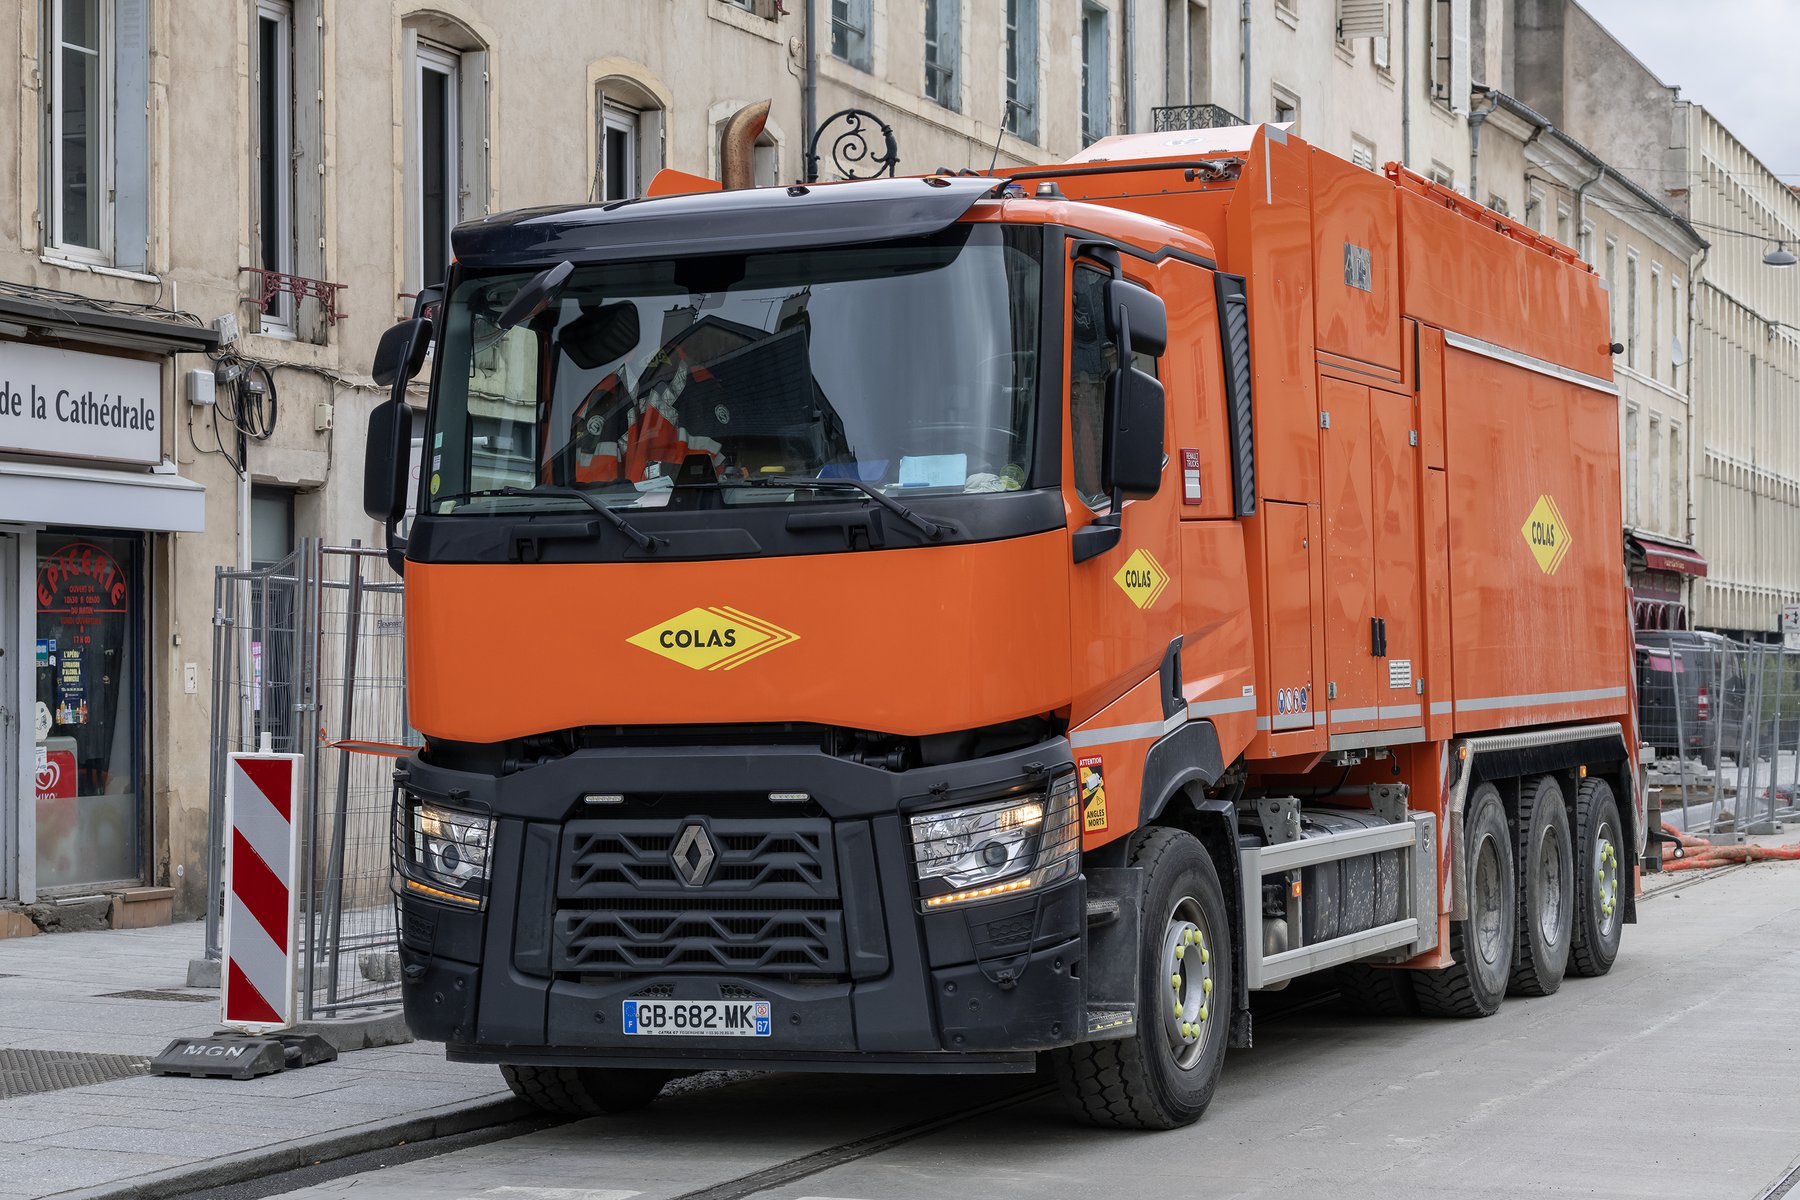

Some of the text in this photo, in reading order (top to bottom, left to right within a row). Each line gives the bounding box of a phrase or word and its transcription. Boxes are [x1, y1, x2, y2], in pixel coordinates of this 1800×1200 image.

[0, 381, 155, 431] de la Cathédrale
[1186, 459, 1200, 468] TRUCKS
[1531, 521, 1555, 547] COLAS
[38, 548, 125, 607] EPICERIE
[1125, 569, 1152, 588] COLAS
[659, 628, 736, 649] COLAS
[1080, 757, 1102, 766] ATTENTION
[1087, 809, 1105, 819] ANGLES
[1088, 817, 1105, 827] MORTS
[638, 1005, 754, 1028] GB-682-MK
[757, 1020, 769, 1032] 67
[183, 1045, 246, 1057] MGN
